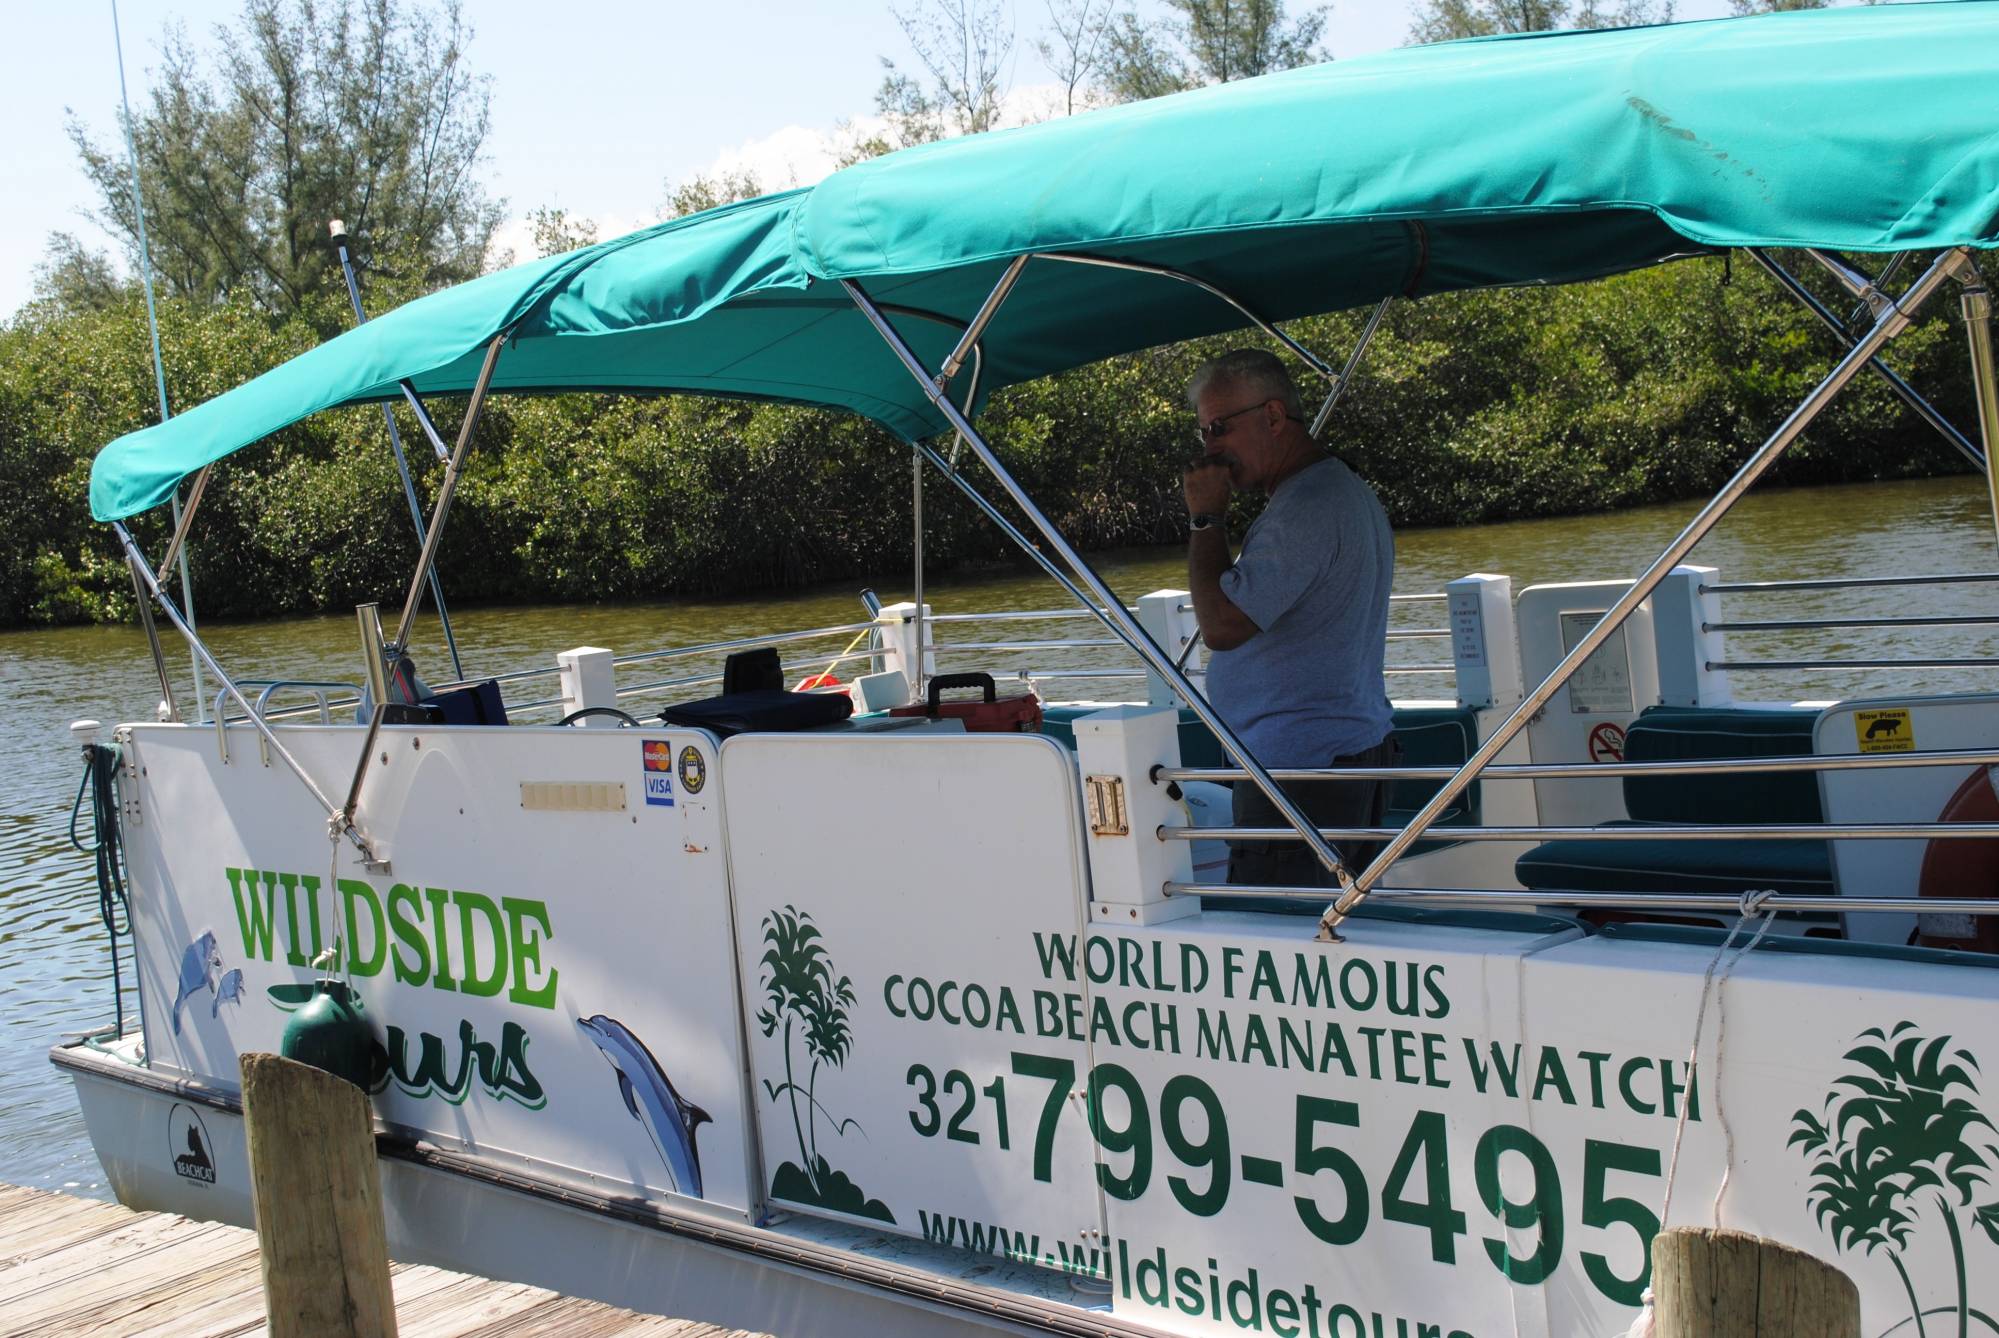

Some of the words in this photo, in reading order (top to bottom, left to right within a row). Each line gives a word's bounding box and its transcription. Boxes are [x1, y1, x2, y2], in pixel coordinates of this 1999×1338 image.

[1879, 711, 1907, 719] Please
[648, 778, 672, 794] VISA
[225, 866, 559, 1010] WILDSIDE
[1032, 931, 1209, 993] WORLD
[1221, 946, 1451, 1019] FAMOUS
[883, 973, 1025, 1034] COCOA
[1032, 989, 1182, 1054] BEACH
[1196, 1007, 1451, 1089] MANATEE
[1461, 1037, 1703, 1122] WATCH
[176, 1161, 214, 1181] BEACHCAT
